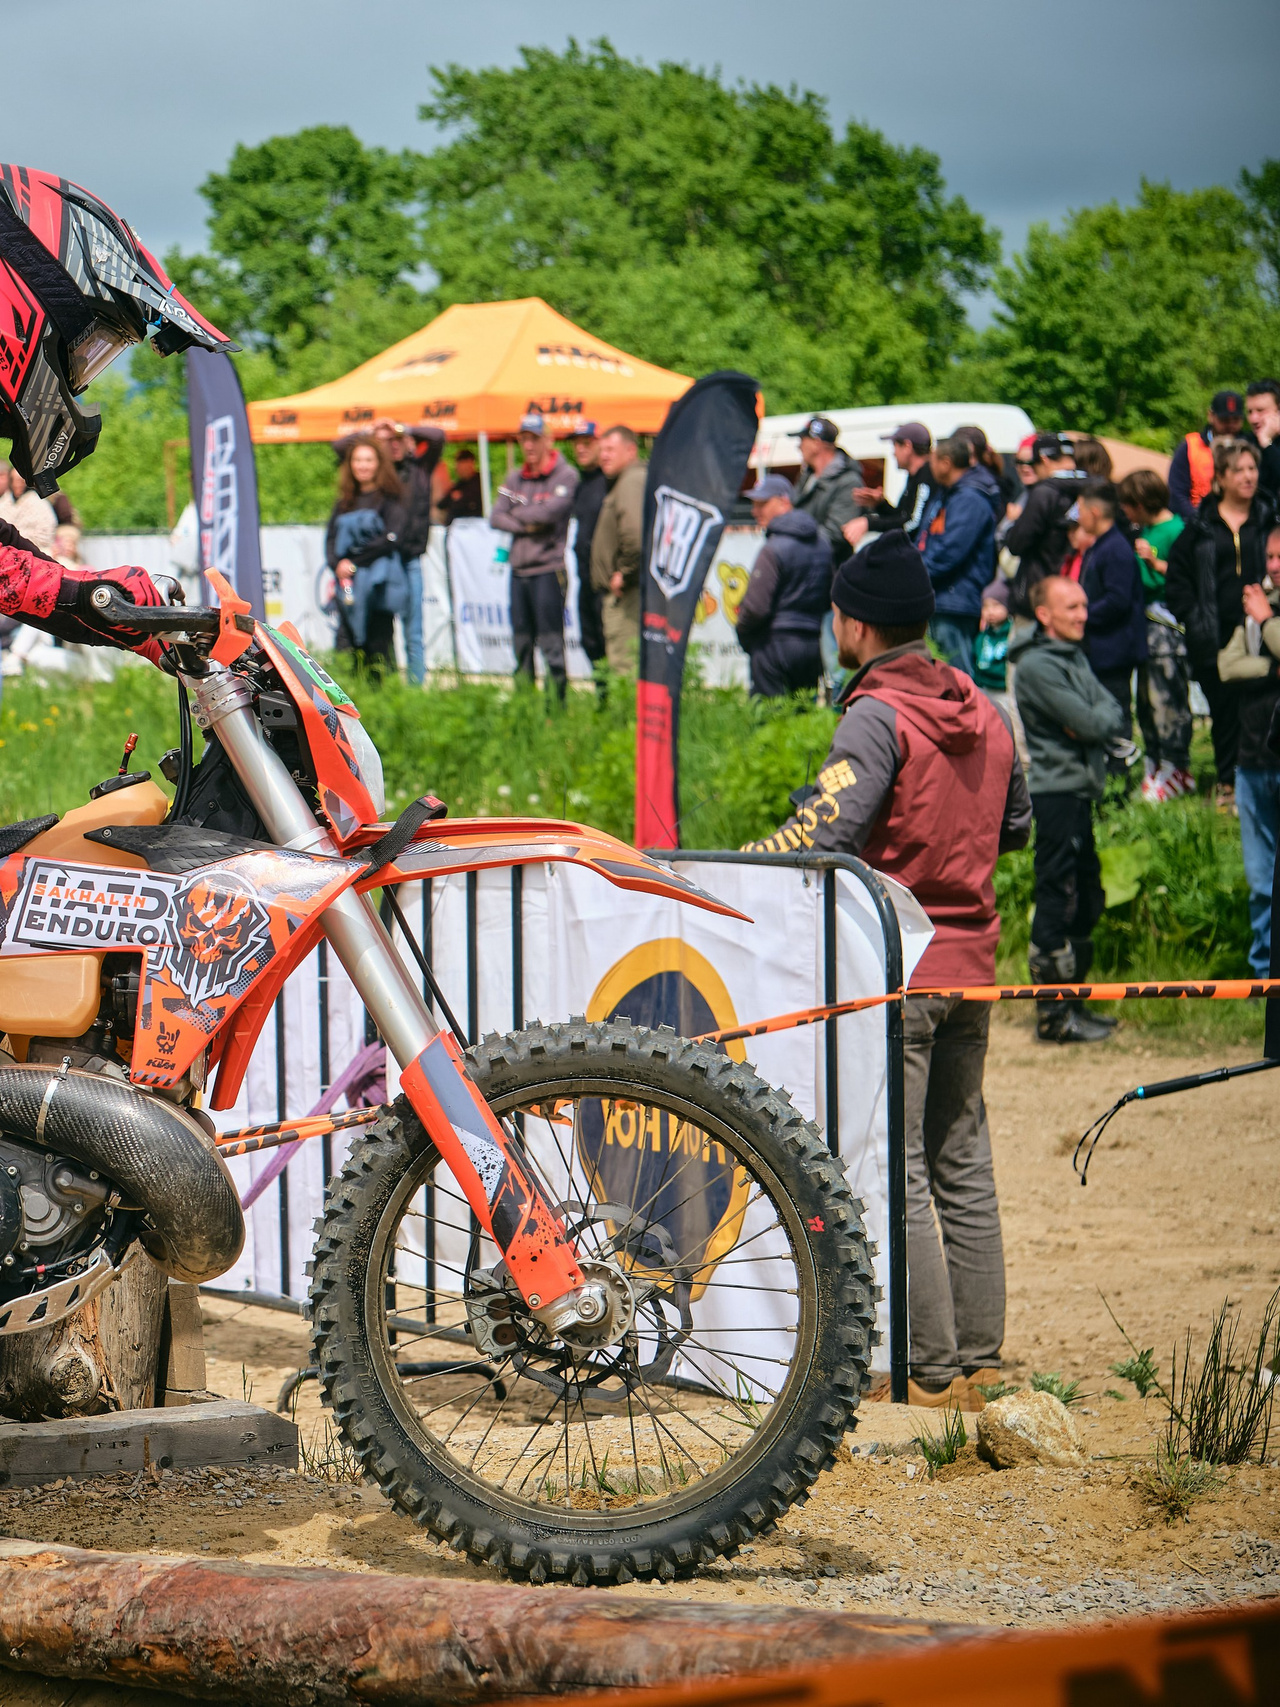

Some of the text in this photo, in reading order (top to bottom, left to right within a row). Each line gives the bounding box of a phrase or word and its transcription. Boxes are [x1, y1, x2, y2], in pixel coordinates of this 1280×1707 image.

[1, 363, 9, 372] 2
[30, 873, 170, 921] HARD
[33, 883, 148, 909] SAKHALIN
[24, 909, 160, 946] ENDURO
[145, 1057, 176, 1070] KTM
